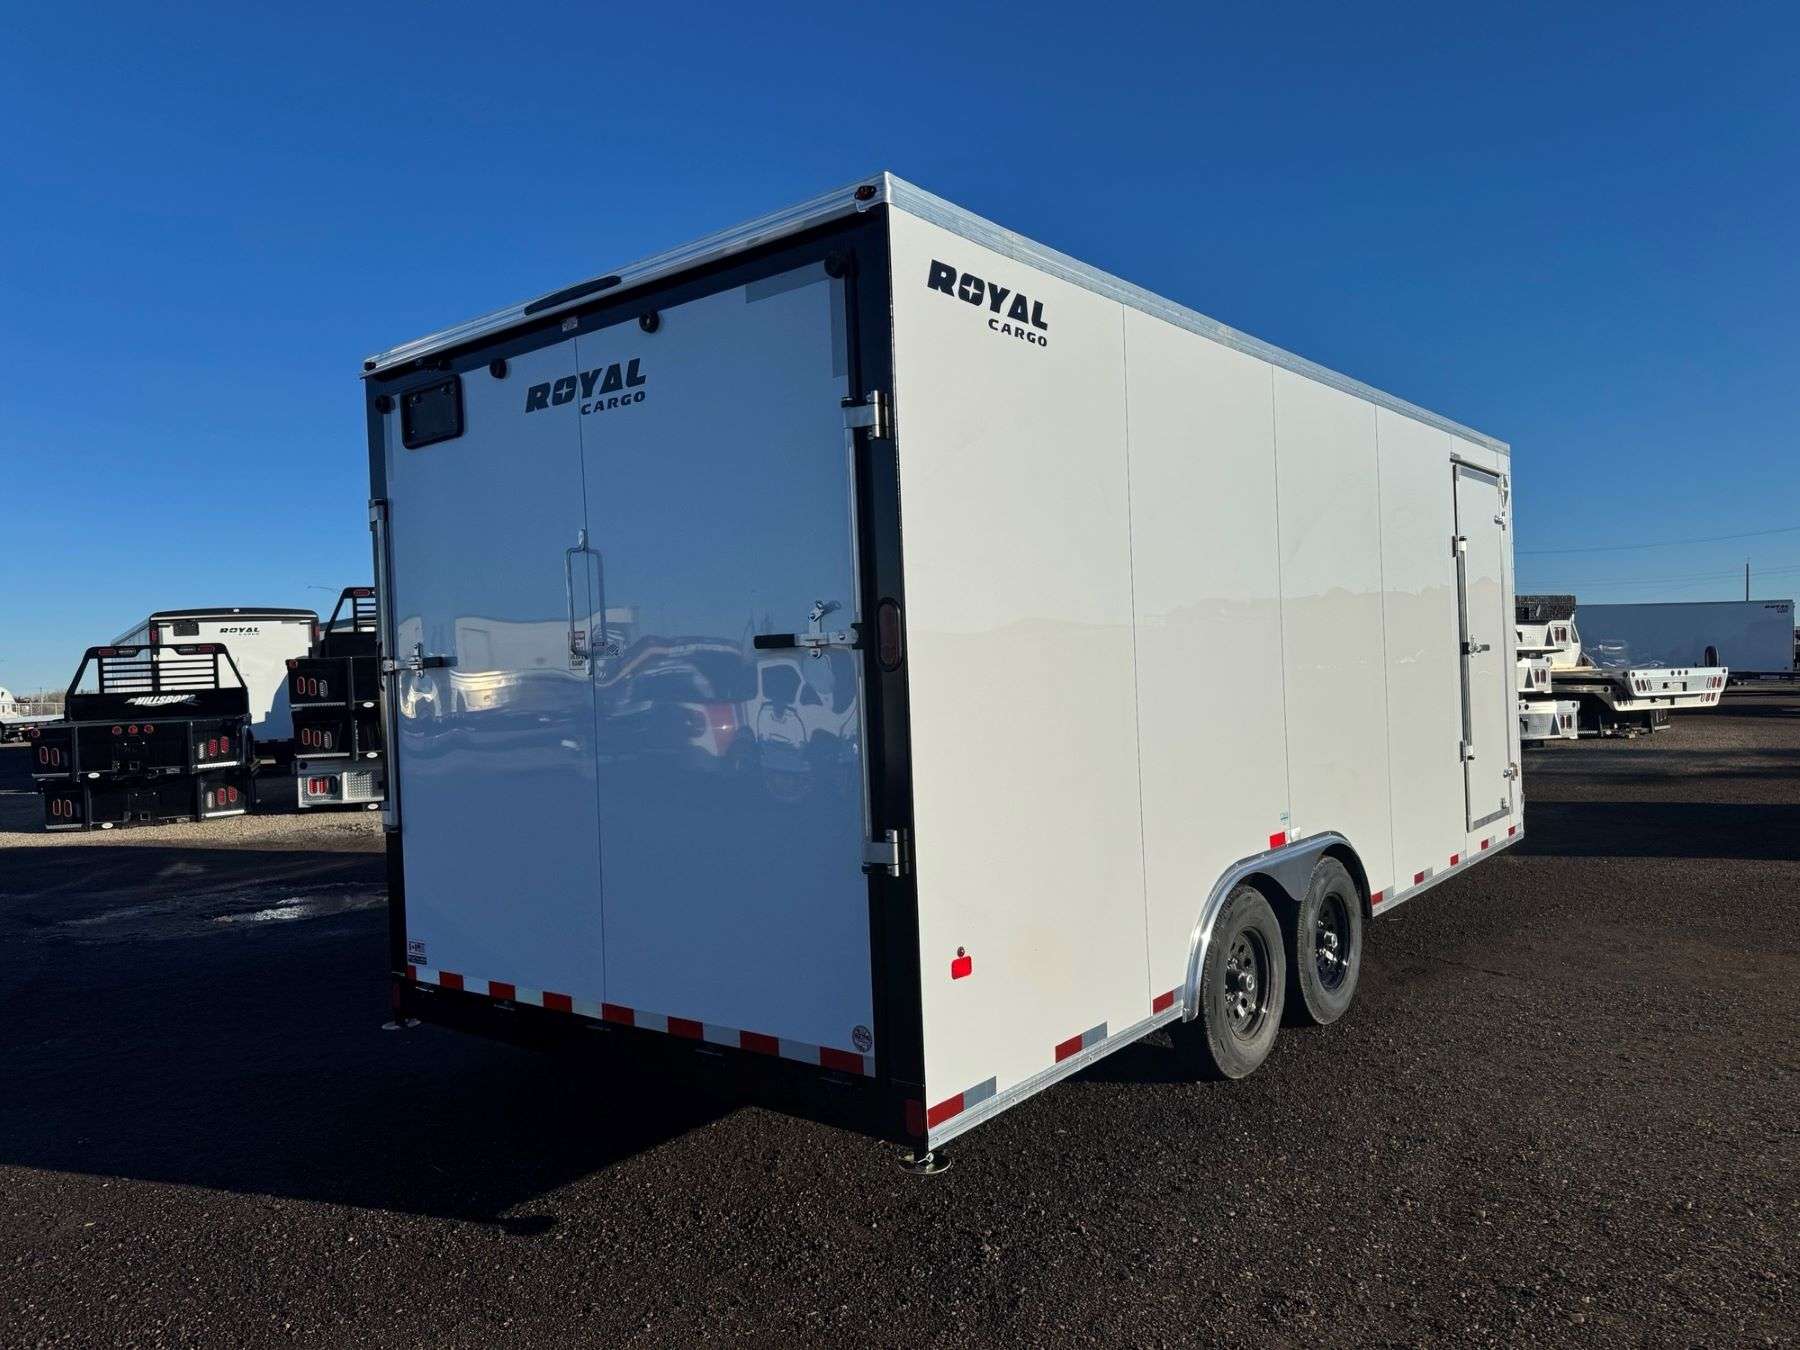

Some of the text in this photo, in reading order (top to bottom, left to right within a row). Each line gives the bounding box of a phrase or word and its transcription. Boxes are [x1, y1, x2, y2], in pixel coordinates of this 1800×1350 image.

[927, 259, 1048, 331] ROYAL
[988, 318, 1048, 347] CARGO
[525, 358, 647, 413] ROYAL
[581, 391, 646, 415] CARGO
